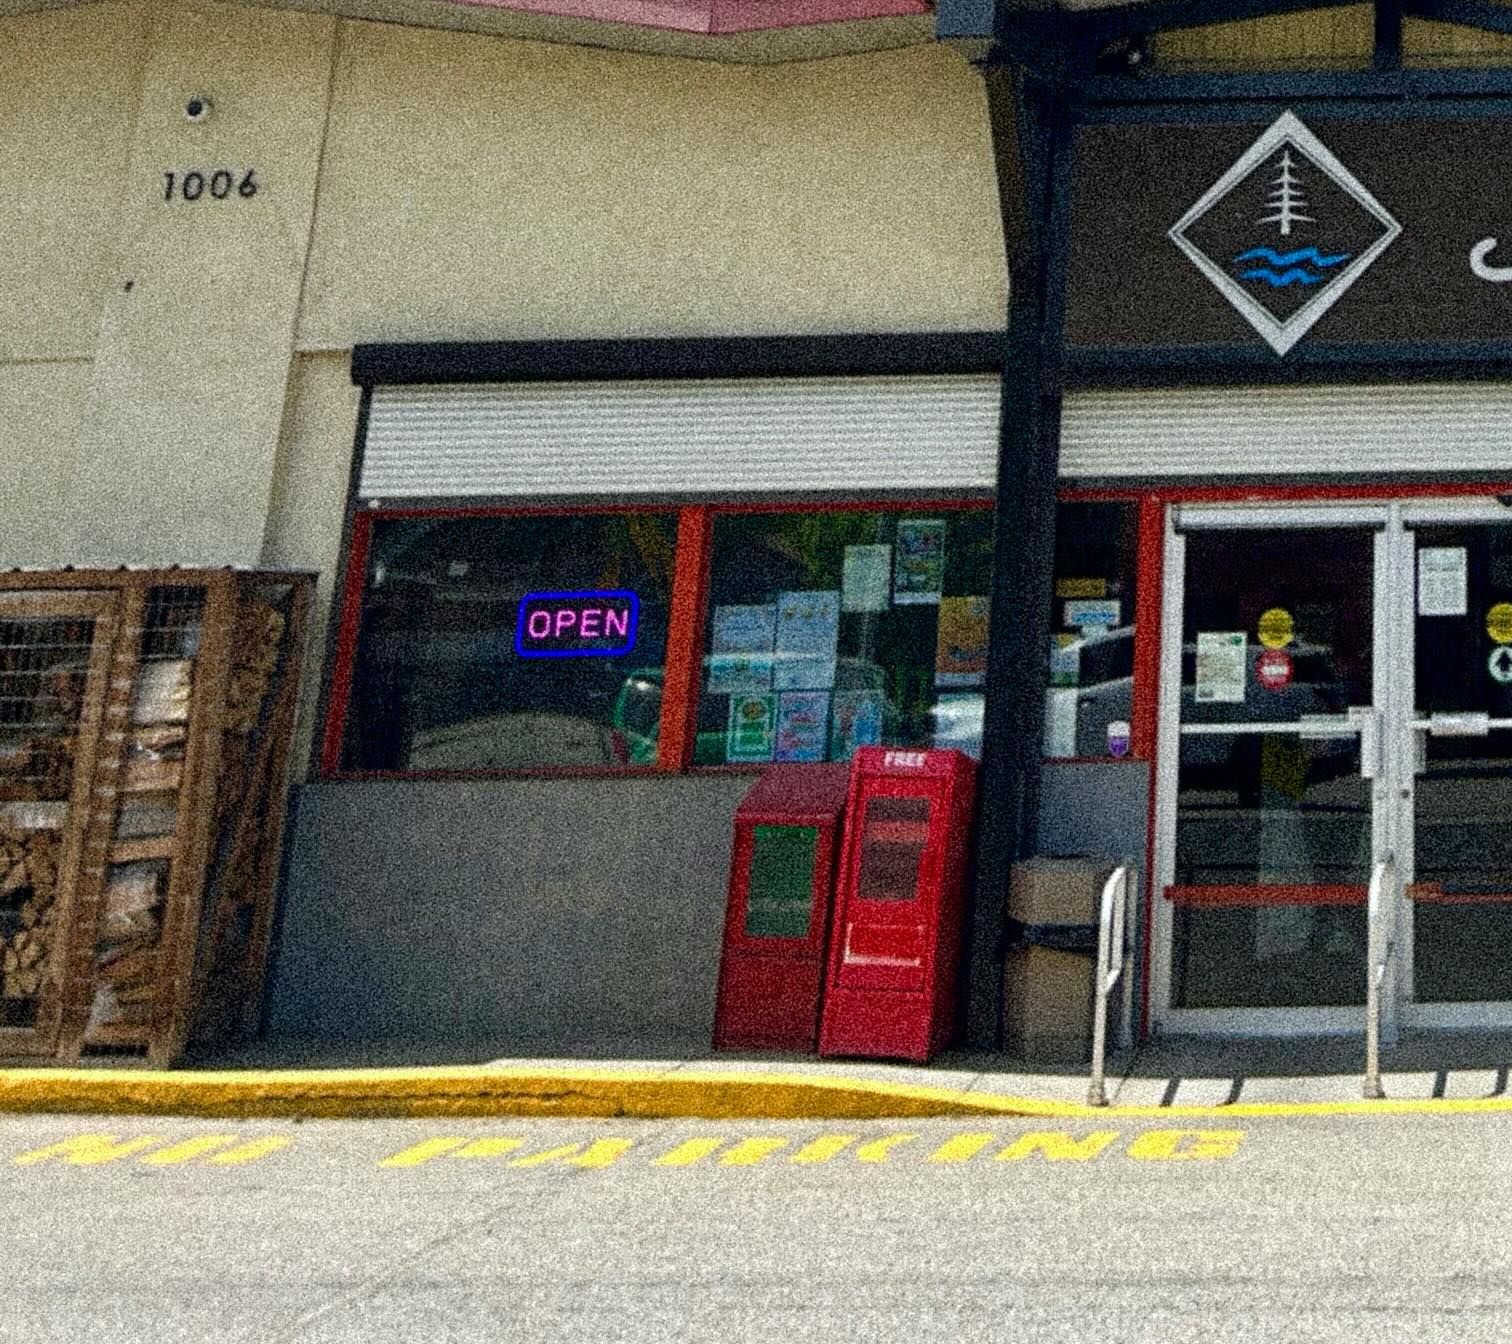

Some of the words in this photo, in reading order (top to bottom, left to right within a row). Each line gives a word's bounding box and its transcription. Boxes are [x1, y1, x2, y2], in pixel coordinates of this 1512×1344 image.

[162, 168, 260, 203] 1006
[527, 608, 629, 640] OPEN
[884, 751, 927, 768] FREE
[12, 1134, 294, 1165] NO
[380, 1129, 1245, 1168] PARKING
